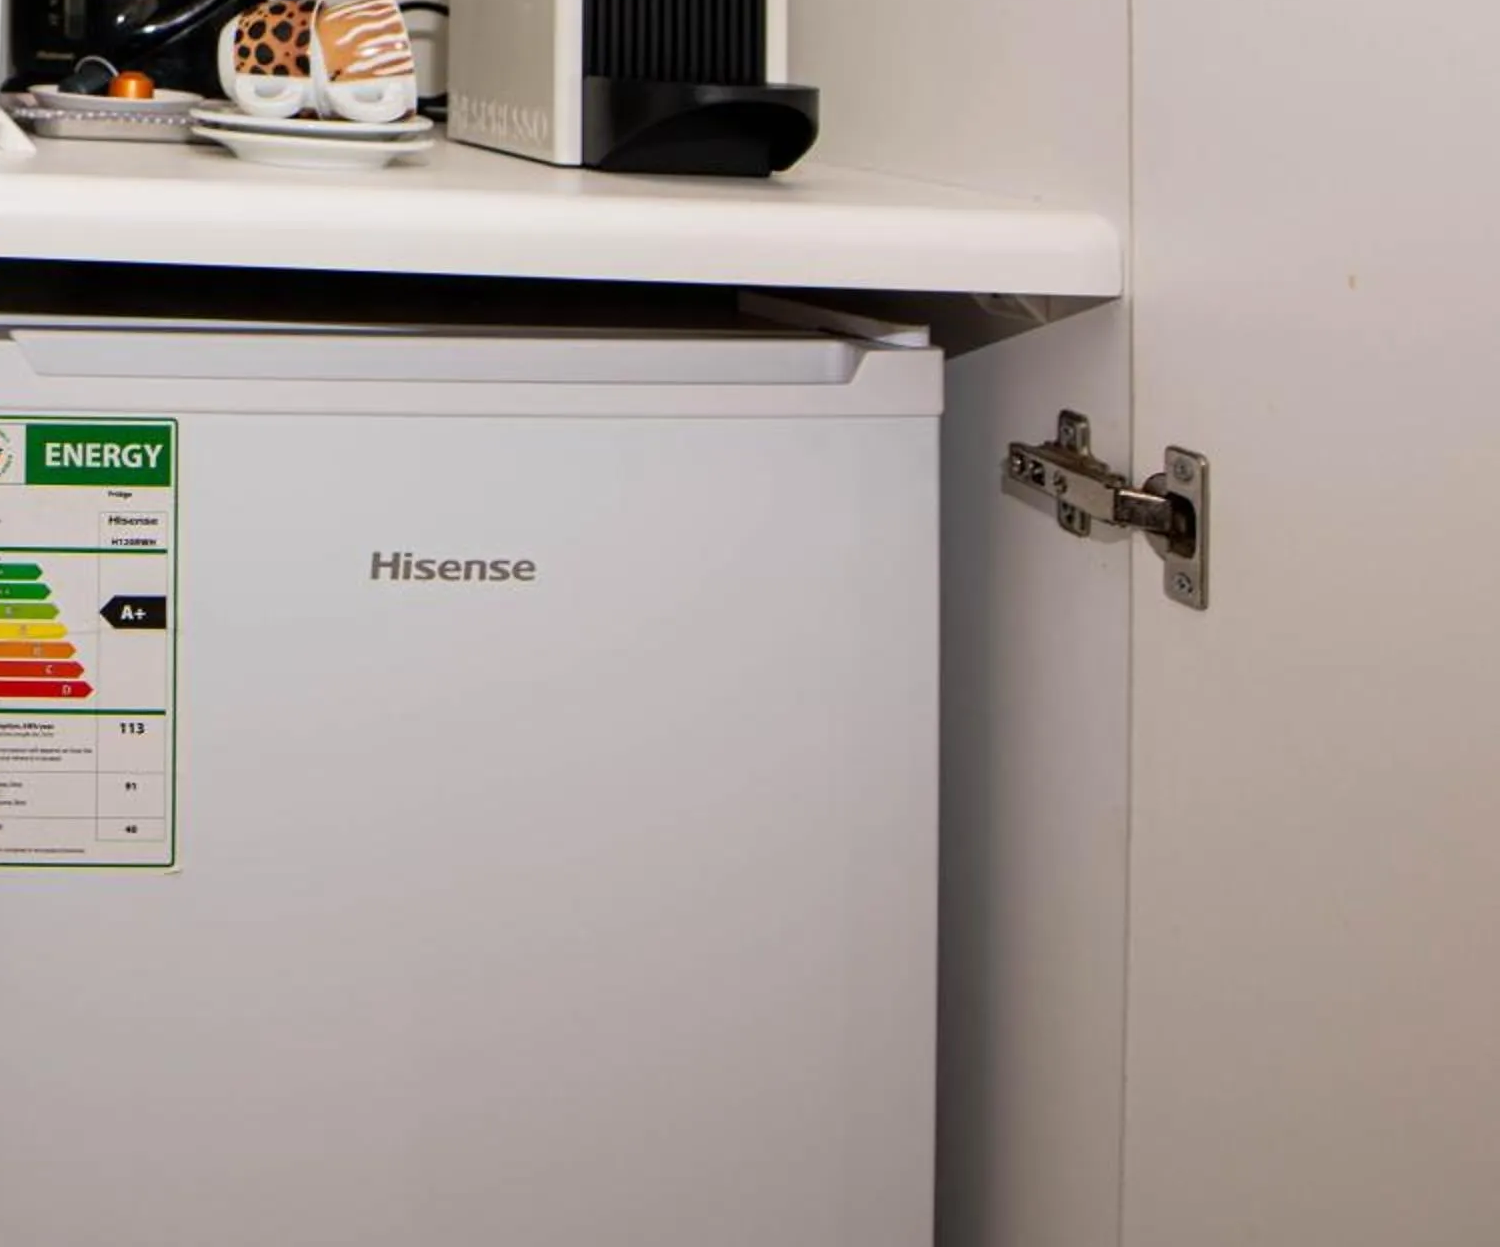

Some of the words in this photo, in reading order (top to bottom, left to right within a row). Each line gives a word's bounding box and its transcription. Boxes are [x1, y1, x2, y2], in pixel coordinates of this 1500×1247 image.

[44, 442, 163, 469] ENERGY
[108, 515, 158, 526] Hisense
[370, 551, 536, 581] Hisense
[120, 604, 147, 620] A+
[45, 664, 54, 675] C
[61, 683, 72, 695] D
[120, 721, 146, 734] 113
